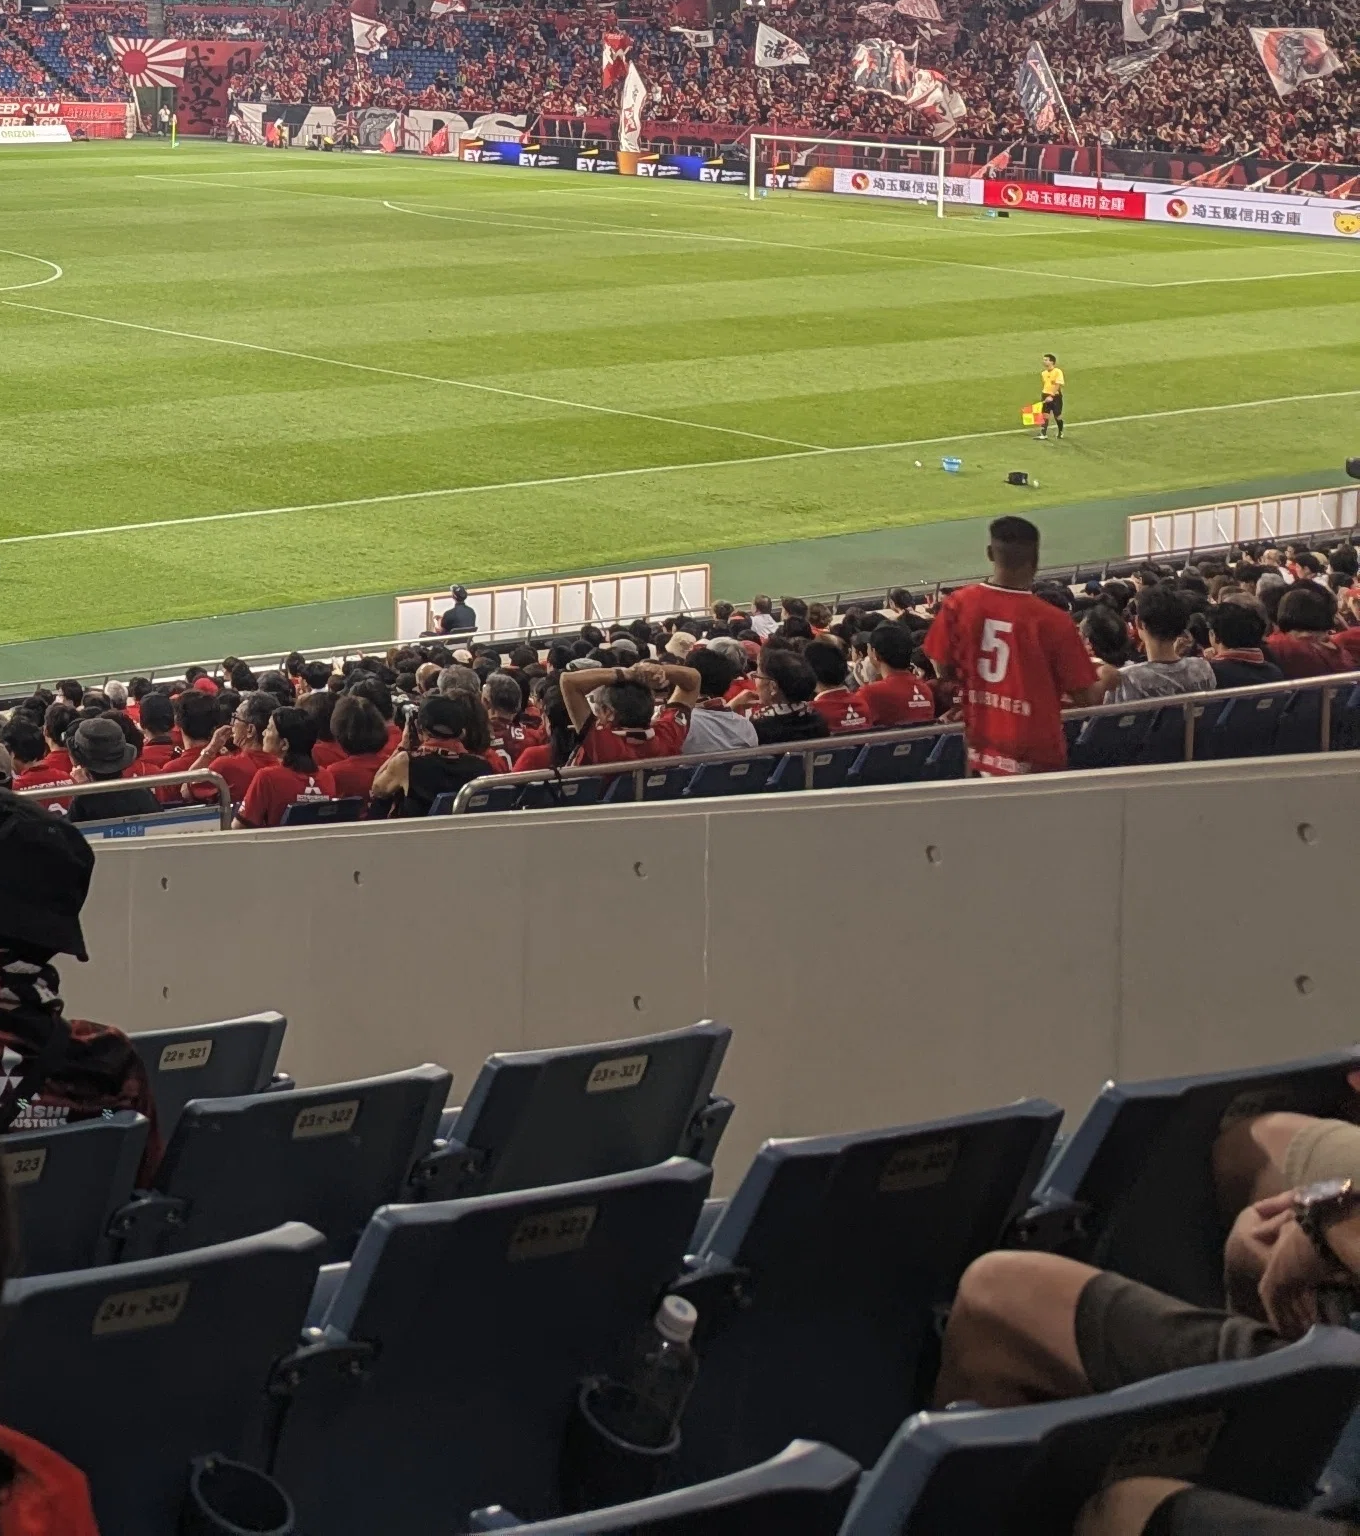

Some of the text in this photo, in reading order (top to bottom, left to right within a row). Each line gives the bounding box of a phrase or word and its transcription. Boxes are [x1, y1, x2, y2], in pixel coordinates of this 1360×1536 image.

[464, 149, 482, 162] EY
[519, 153, 537, 166] EY
[576, 157, 595, 171] EY
[637, 162, 656, 176] EY
[699, 167, 721, 182] EY
[765, 173, 788, 188] EY
[976, 618, 1013, 683] 5
